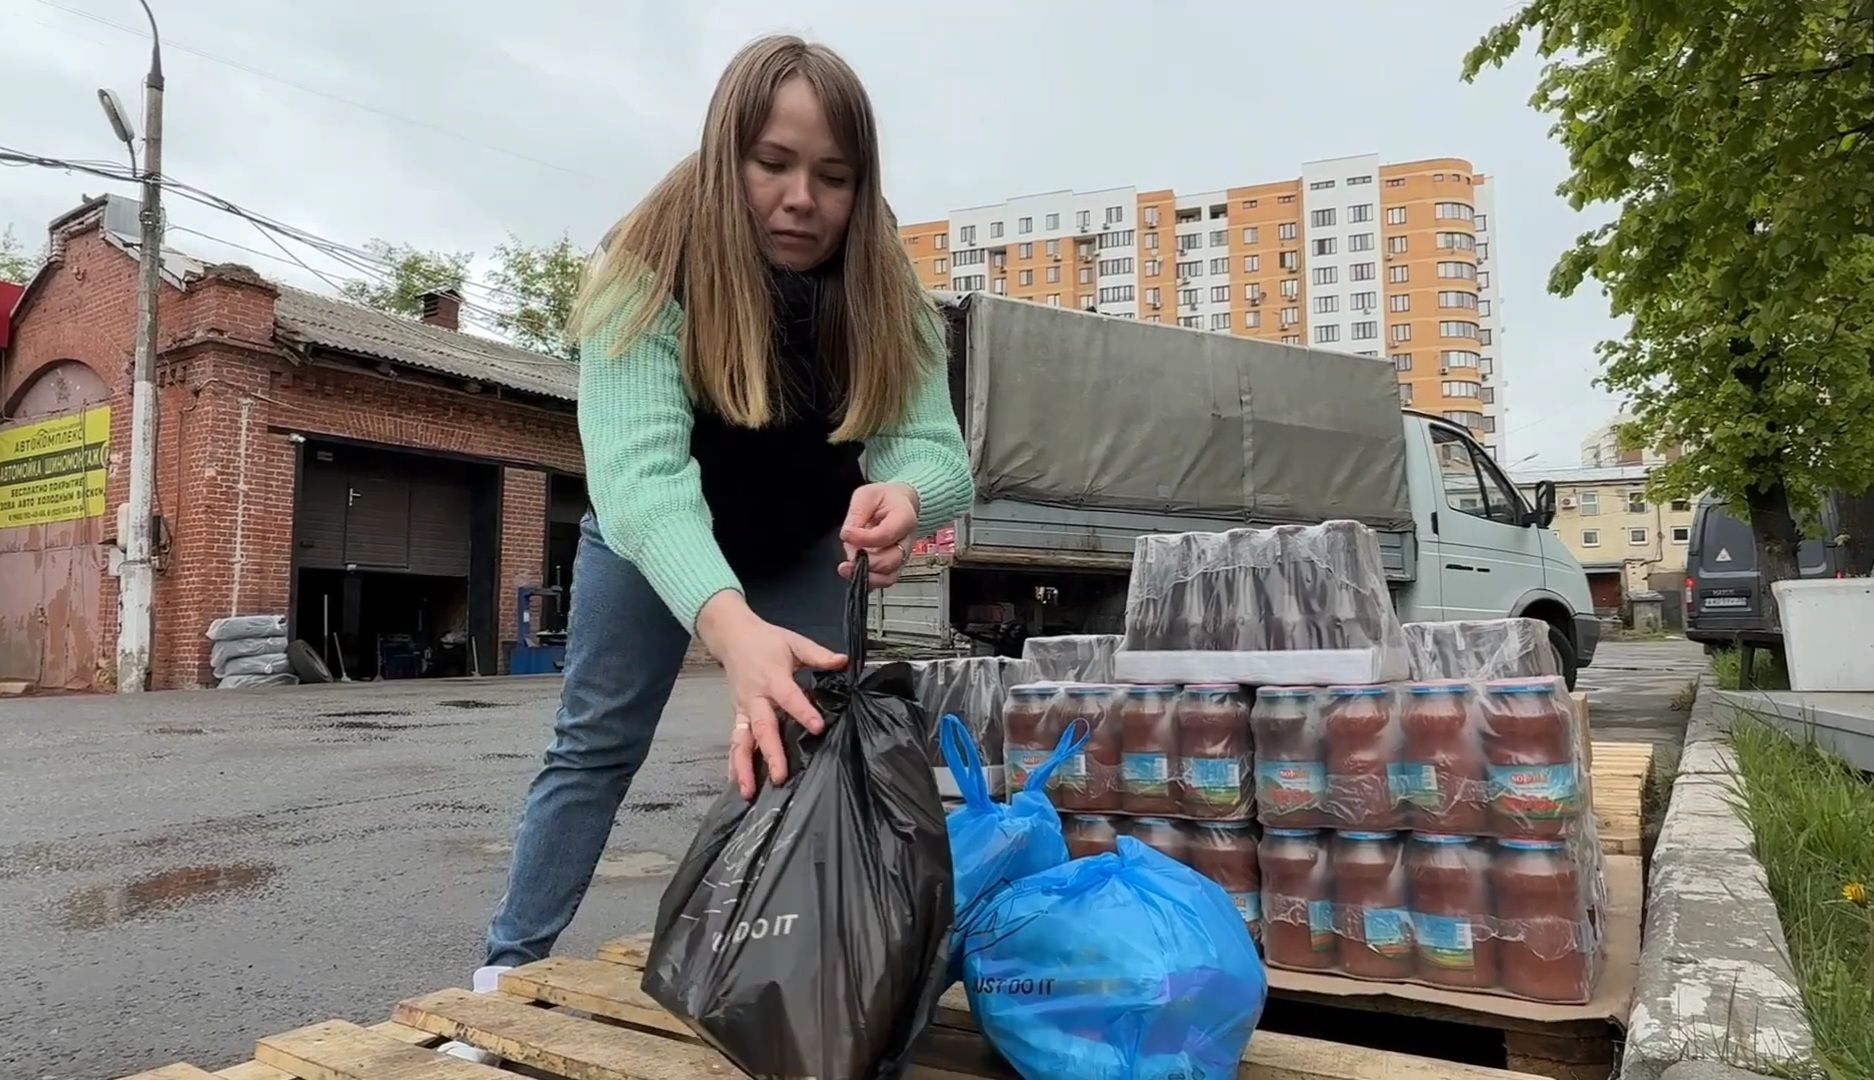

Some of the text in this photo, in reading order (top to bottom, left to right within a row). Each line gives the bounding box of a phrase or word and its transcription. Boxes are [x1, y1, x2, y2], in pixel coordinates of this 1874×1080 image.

[14, 428, 82, 453] АВТОКОМПЛЕКС
[11, 477, 85, 498] БЕСПЛАТНО ПОКРЫТИЕ
[18, 498, 34, 508] АВТО
[37, 492, 74, 505] ХОЛОДНЫМ
[76, 487, 104, 500] ВСКОМ
[732, 918, 769, 943] DO
[773, 914, 799, 936] IT
[1008, 978, 1034, 995] DO
[1038, 978, 1056, 995] IT
